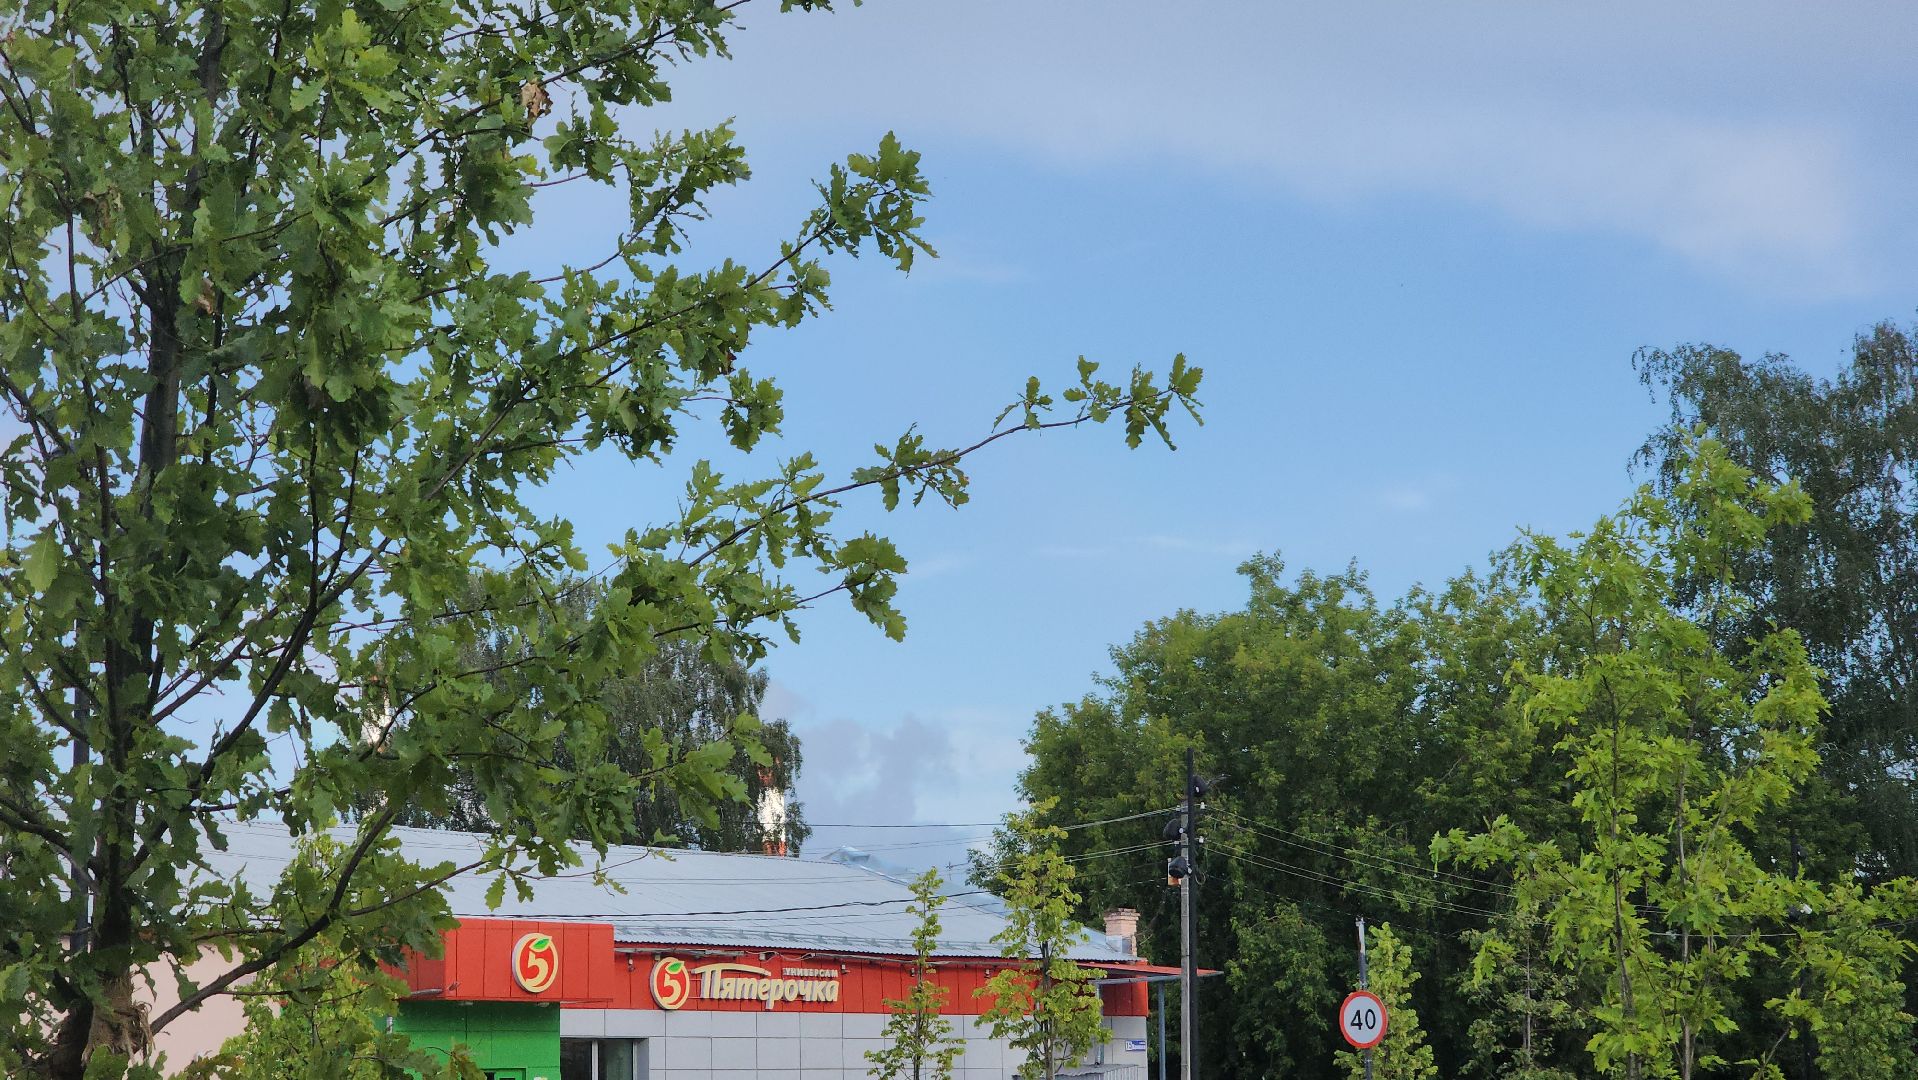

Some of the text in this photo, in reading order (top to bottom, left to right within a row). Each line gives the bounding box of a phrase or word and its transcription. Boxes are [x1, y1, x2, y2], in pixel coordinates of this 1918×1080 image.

[523, 938, 551, 988] 5
[661, 961, 840, 1010] 5 Пятерочка
[1351, 1009, 1376, 1030] 40
